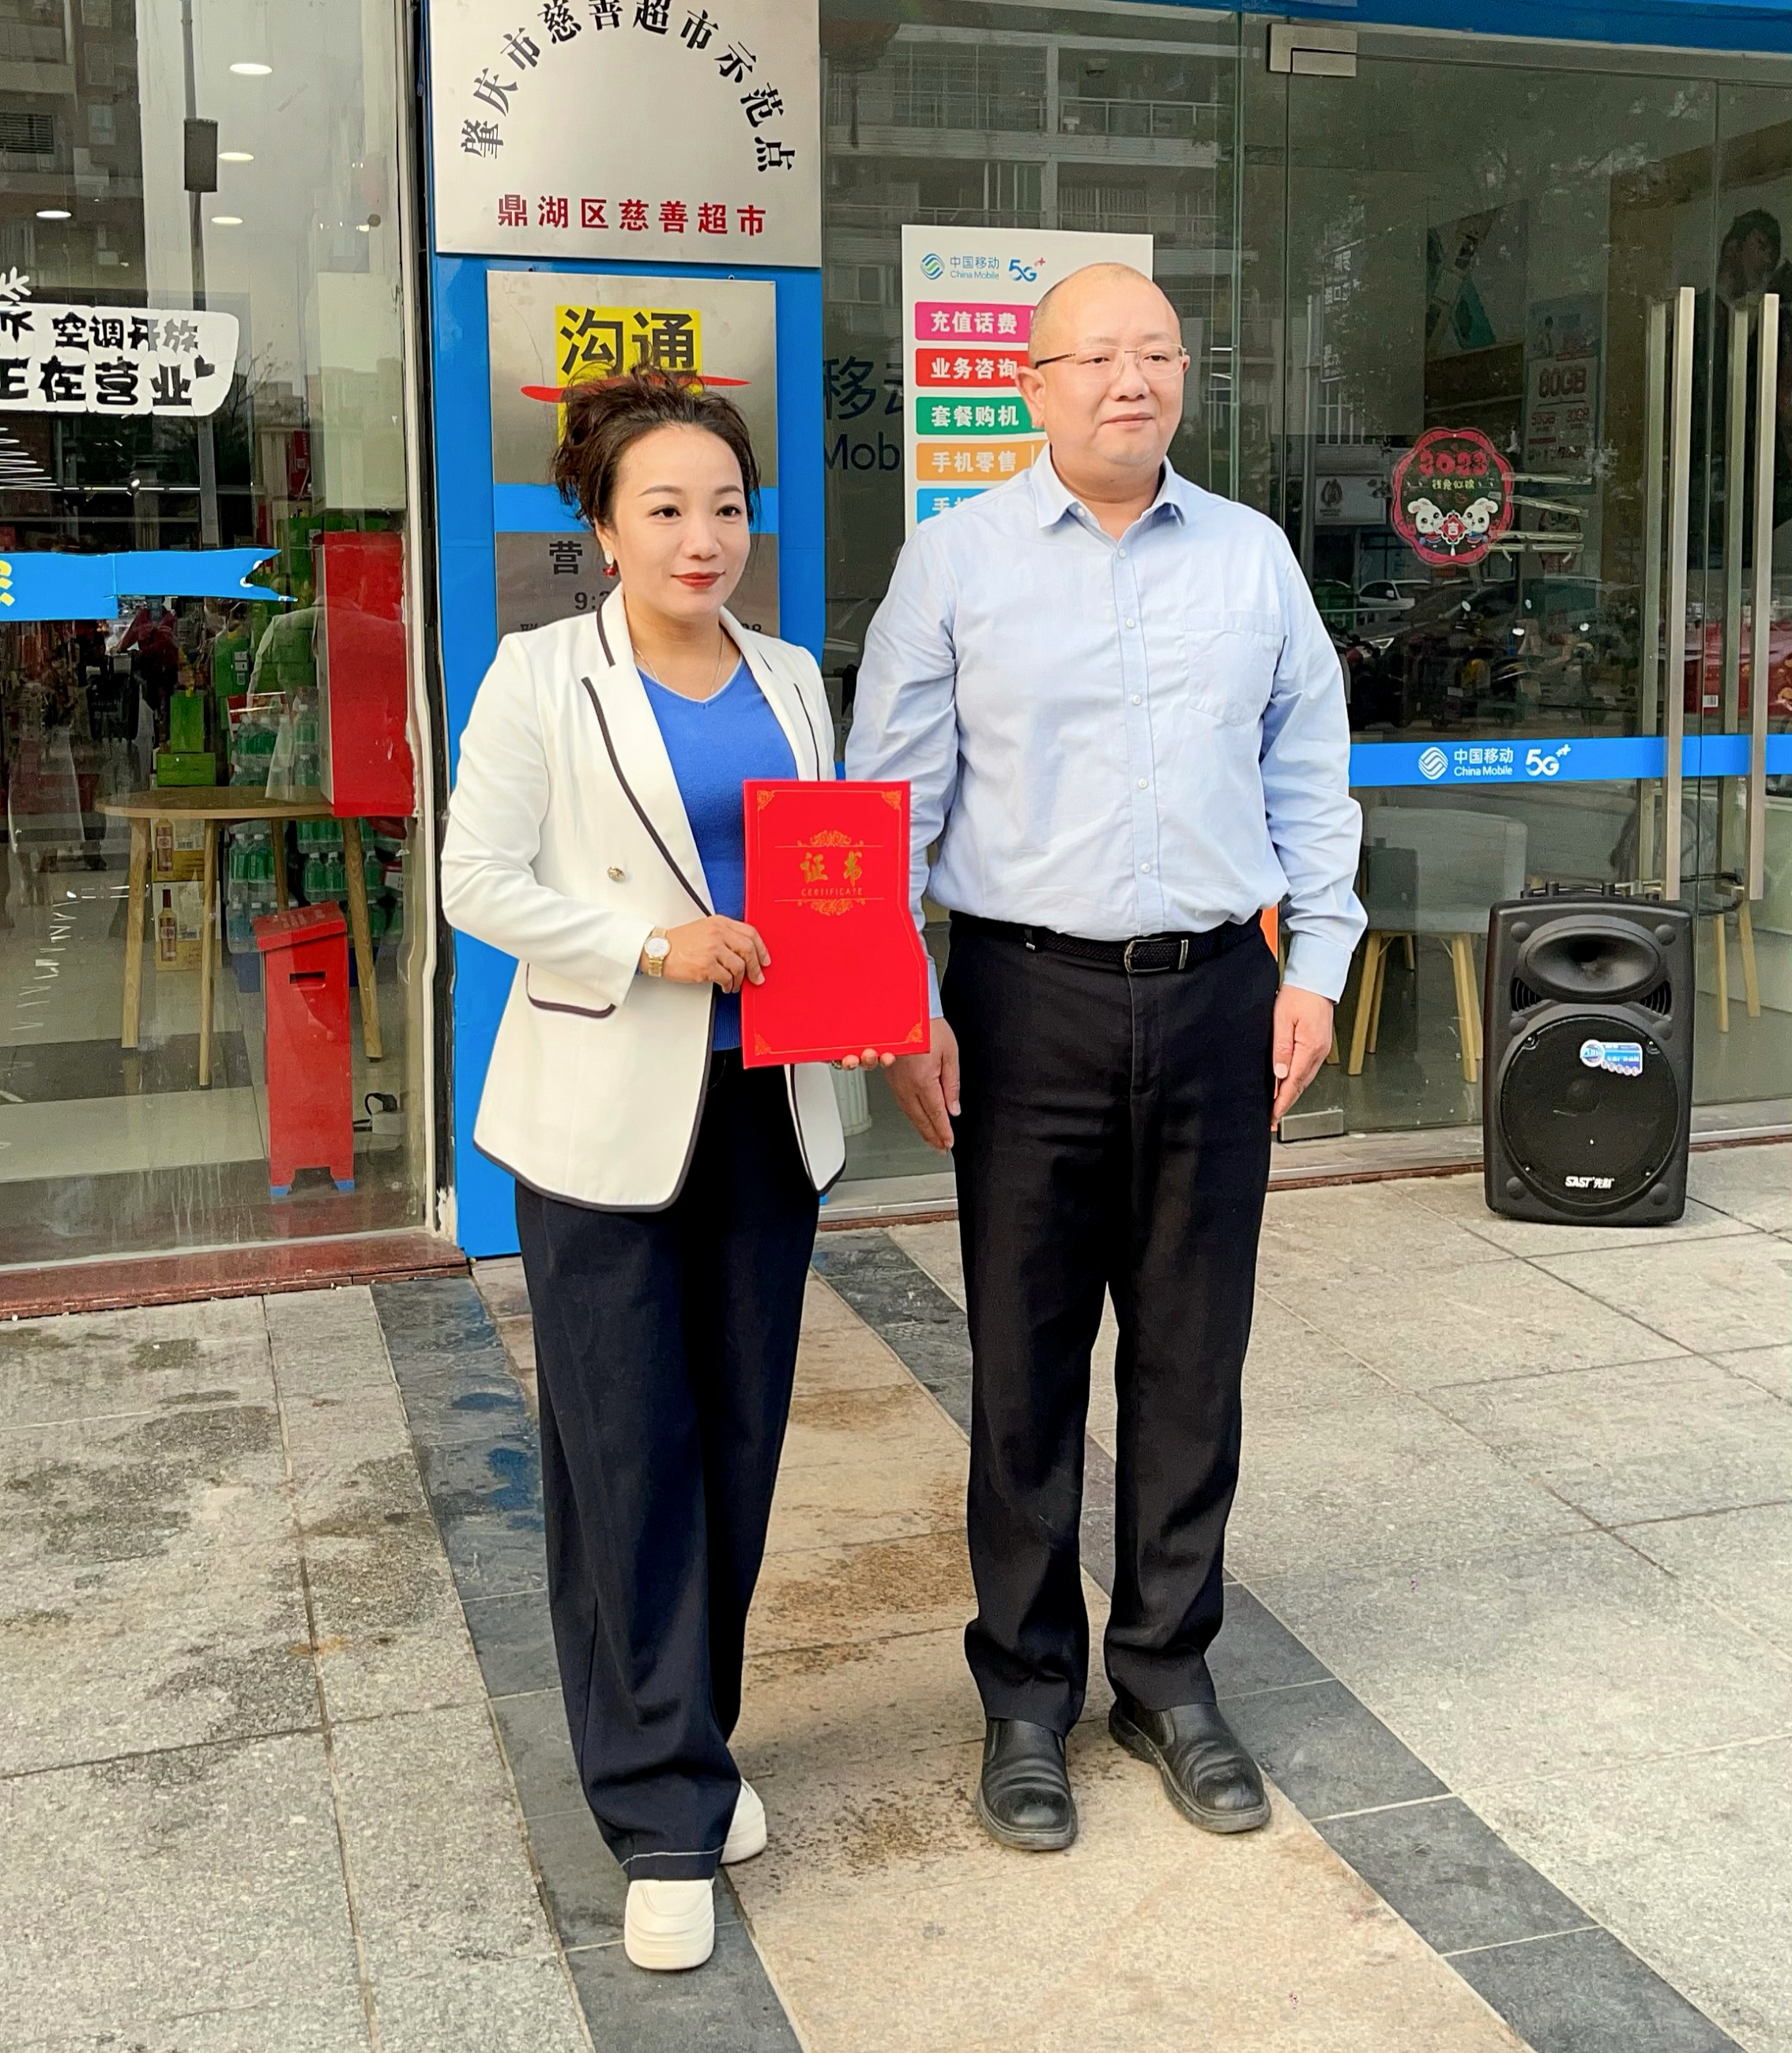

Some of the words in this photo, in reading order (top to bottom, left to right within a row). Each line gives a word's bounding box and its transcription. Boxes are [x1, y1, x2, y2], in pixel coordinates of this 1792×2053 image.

[461, 0, 796, 172] 肇庆市慈善超市示范点
[497, 194, 766, 237] 鼎湖区慈善超市
[950, 255, 1000, 270] 中国移动
[950, 270, 973, 279] China
[973, 271, 1000, 280] Mobile
[931, 311, 1018, 335] 充值话费
[560, 307, 698, 378] 沟通
[930, 357, 1018, 380] 业务咨询
[931, 405, 1019, 428] 套餐购机
[931, 450, 1017, 473] 手机零售
[1419, 450, 1488, 477] 2023
[549, 541, 583, 575] 营
[1454, 747, 1514, 764] 中国移动
[1454, 766, 1481, 777] China
[1482, 764, 1513, 776] Mobile
[800, 850, 864, 887] 证书
[800, 887, 863, 897] CERTIFICATE
[1564, 1175, 1594, 1188] SAST
